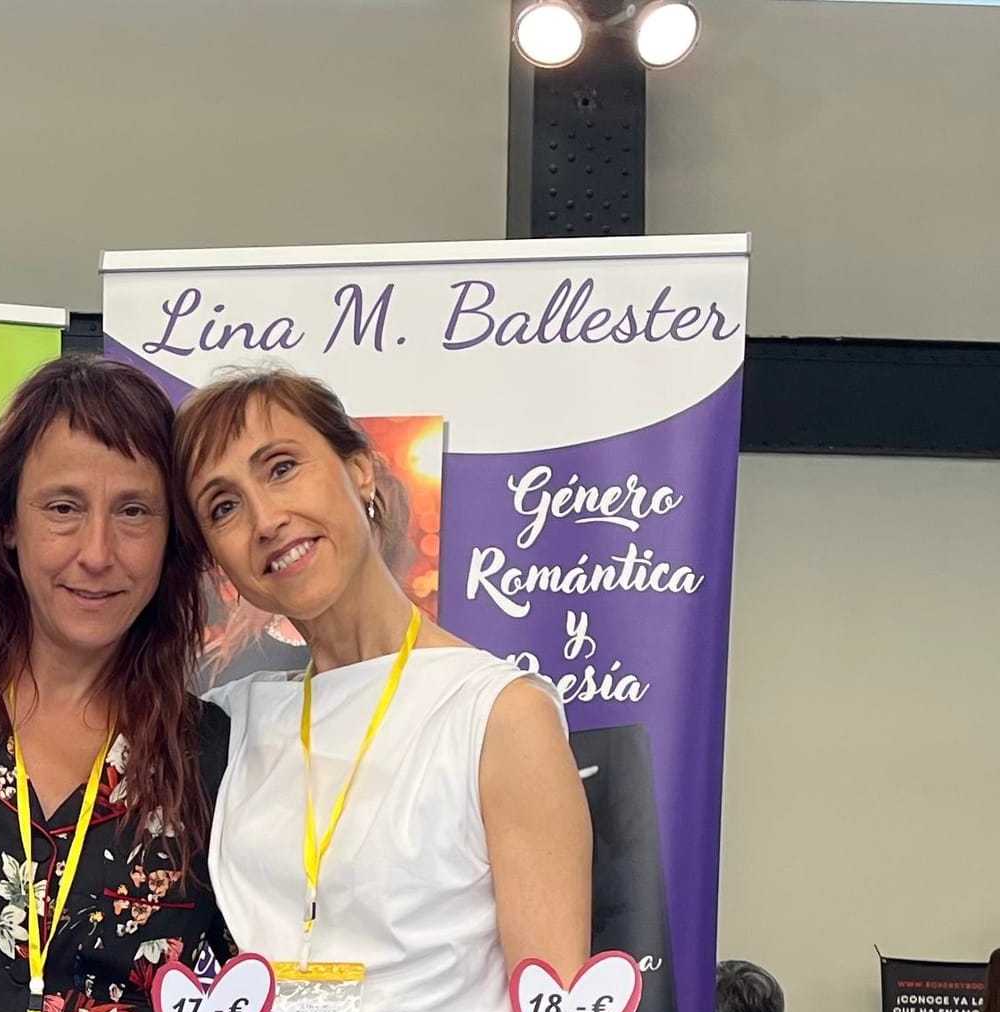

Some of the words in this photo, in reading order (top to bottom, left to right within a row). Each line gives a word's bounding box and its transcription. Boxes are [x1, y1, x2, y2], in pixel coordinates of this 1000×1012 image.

[142, 287, 303, 357] Lina
[322, 283, 406, 354] M.
[443, 277, 741, 351] Ballester
[507, 466, 683, 549] Género
[467, 543, 704, 618] Romántica
[564, 610, 596, 660] y
[953, 997, 968, 1006] YA
